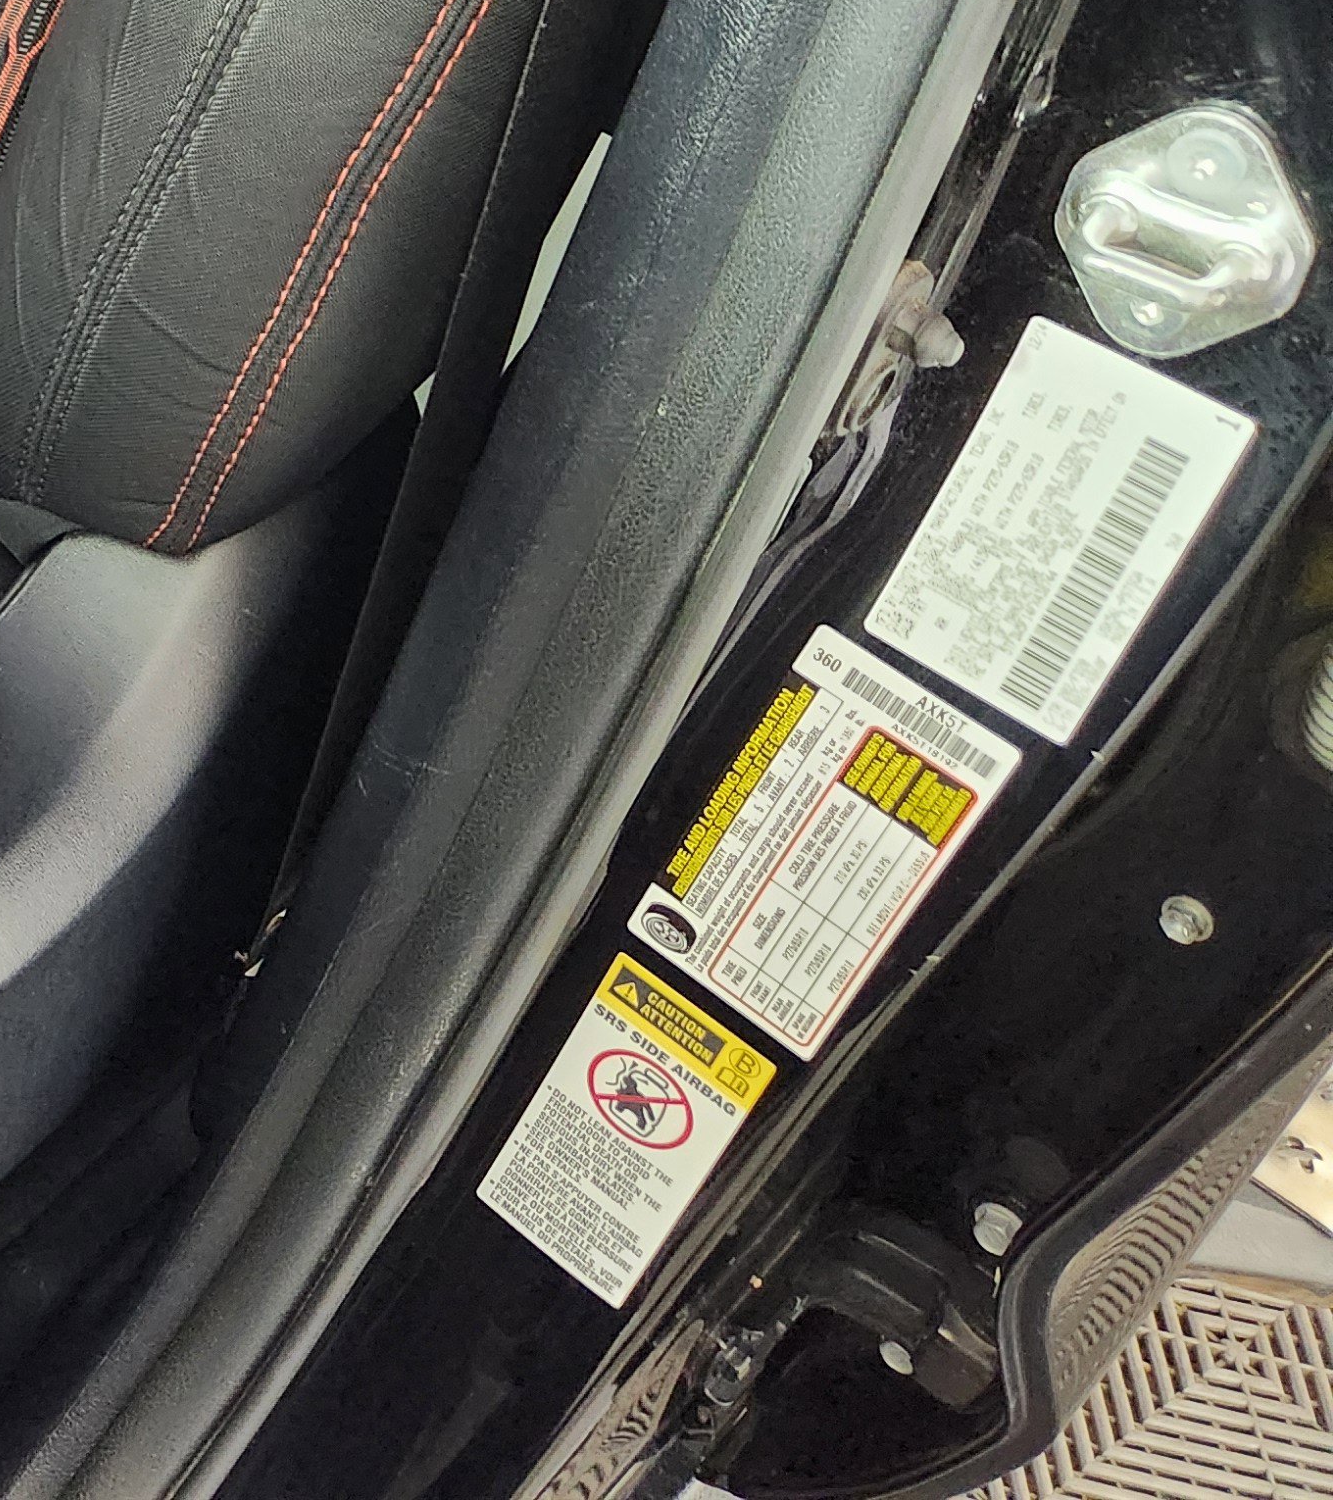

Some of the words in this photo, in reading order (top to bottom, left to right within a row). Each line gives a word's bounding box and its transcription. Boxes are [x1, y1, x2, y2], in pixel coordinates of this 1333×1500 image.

[811, 646, 843, 673] 360
[767, 682, 816, 747] CHARGEMENT
[787, 728, 805, 749] REAR
[914, 693, 968, 735] AXK5T
[752, 752, 770, 770] ET
[760, 740, 778, 758] LE
[875, 739, 897, 763] FOR
[664, 846, 691, 879] TIRE
[681, 821, 707, 853] AND
[697, 768, 741, 827] LOADING
[731, 686, 795, 775] INFORMATION
[724, 790, 745, 813] LES
[735, 763, 763, 798] PNEUS
[757, 770, 777, 795] FRONT
[767, 776, 787, 802] AVANT
[842, 766, 862, 788] SEE
[713, 807, 734, 831] SUR
[728, 814, 748, 838] TOTAL
[738, 821, 758, 845] TOTAL
[746, 853, 760, 869] and
[755, 836, 773, 857] cargo
[766, 813, 786, 838] should
[781, 795, 799, 816] never
[793, 771, 814, 797] exceed
[787, 853, 806, 875] COLD
[800, 837, 816, 856] TIRE
[810, 801, 840, 840] PRESSURE
[811, 844, 827, 861] DES
[838, 799, 857, 822] FROID
[684, 878, 708, 908] SEATING
[701, 846, 728, 881] CAPACITY
[716, 851, 739, 879] PLACES
[751, 912, 767, 930] SIZE
[753, 905, 786, 950] DIMENSIONS
[638, 1001, 714, 1063] ATTENTION
[645, 990, 707, 1041] CAUTION
[592, 1002, 628, 1033] SRS
[628, 1029, 670, 1065] SIDE
[670, 1061, 738, 1117] AIRBAG
[734, 1051, 757, 1076] B
[523, 1133, 544, 1153] FOR
[543, 1149, 585, 1186] DETAILS.
[532, 1118, 556, 1140] SIDE
[555, 1135, 591, 1168] AIRBAG
[590, 1163, 637, 1204] INFLATES.
[537, 1110, 579, 1147] SERIOUS
[577, 1142, 614, 1175] INJURY
[612, 1169, 642, 1197] WHEN
[641, 1193, 662, 1213] THE
[542, 1103, 592, 1146] POTENTIAL
[591, 1142, 624, 1171] DEATH
[622, 1166, 639, 1183] OR
[546, 1095, 579, 1124] FRONT
[577, 1120, 607, 1146] DOOR
[605, 1141, 621, 1157] TO
[620, 1153, 651, 1181] AVOID
[551, 1088, 567, 1104] DO
[566, 1099, 587, 1120] NOT
[587, 1115, 613, 1139] LEAN
[611, 1135, 654, 1172] AGAINST
[653, 1168, 673, 1187] THE
[518, 1142, 533, 1158] NE
[531, 1153, 551, 1173] PAS
[550, 1168, 603, 1214] S'APPUYER
[601, 1209, 640, 1244] CONTRE
[528, 1125, 547, 1144] SEE
[546, 1140, 590, 1179] OWNER'S
[589, 1174, 630, 1210] MANUAL
[489, 1190, 502, 1204] LE
[500, 1199, 538, 1233] MANUEL
[536, 1229, 552, 1245] DU
[498, 1174, 530, 1203] GRAVE
[528, 1198, 544, 1215] OU
[543, 1211, 595, 1256] MORTELLE.
[503, 1166, 541, 1200] DONNER
[539, 1195, 561, 1216] LIEU
[567, 1218, 587, 1237] UNE
[586, 1232, 633, 1274] BLESSURE
[508, 1158, 555, 1199] POURRAIT
[553, 1195, 568, 1210] SE
[567, 1206, 611, 1245] GONFLER
[610, 1240, 624, 1255] ET
[513, 1150, 527, 1165] LA
[600, 1220, 643, 1259] L'AIRBAG
[494, 1182, 520, 1207] POUR
[519, 1203, 545, 1227] PLUS
[543, 1223, 558, 1238] DE
[598, 1266, 623, 1289] VOIR
